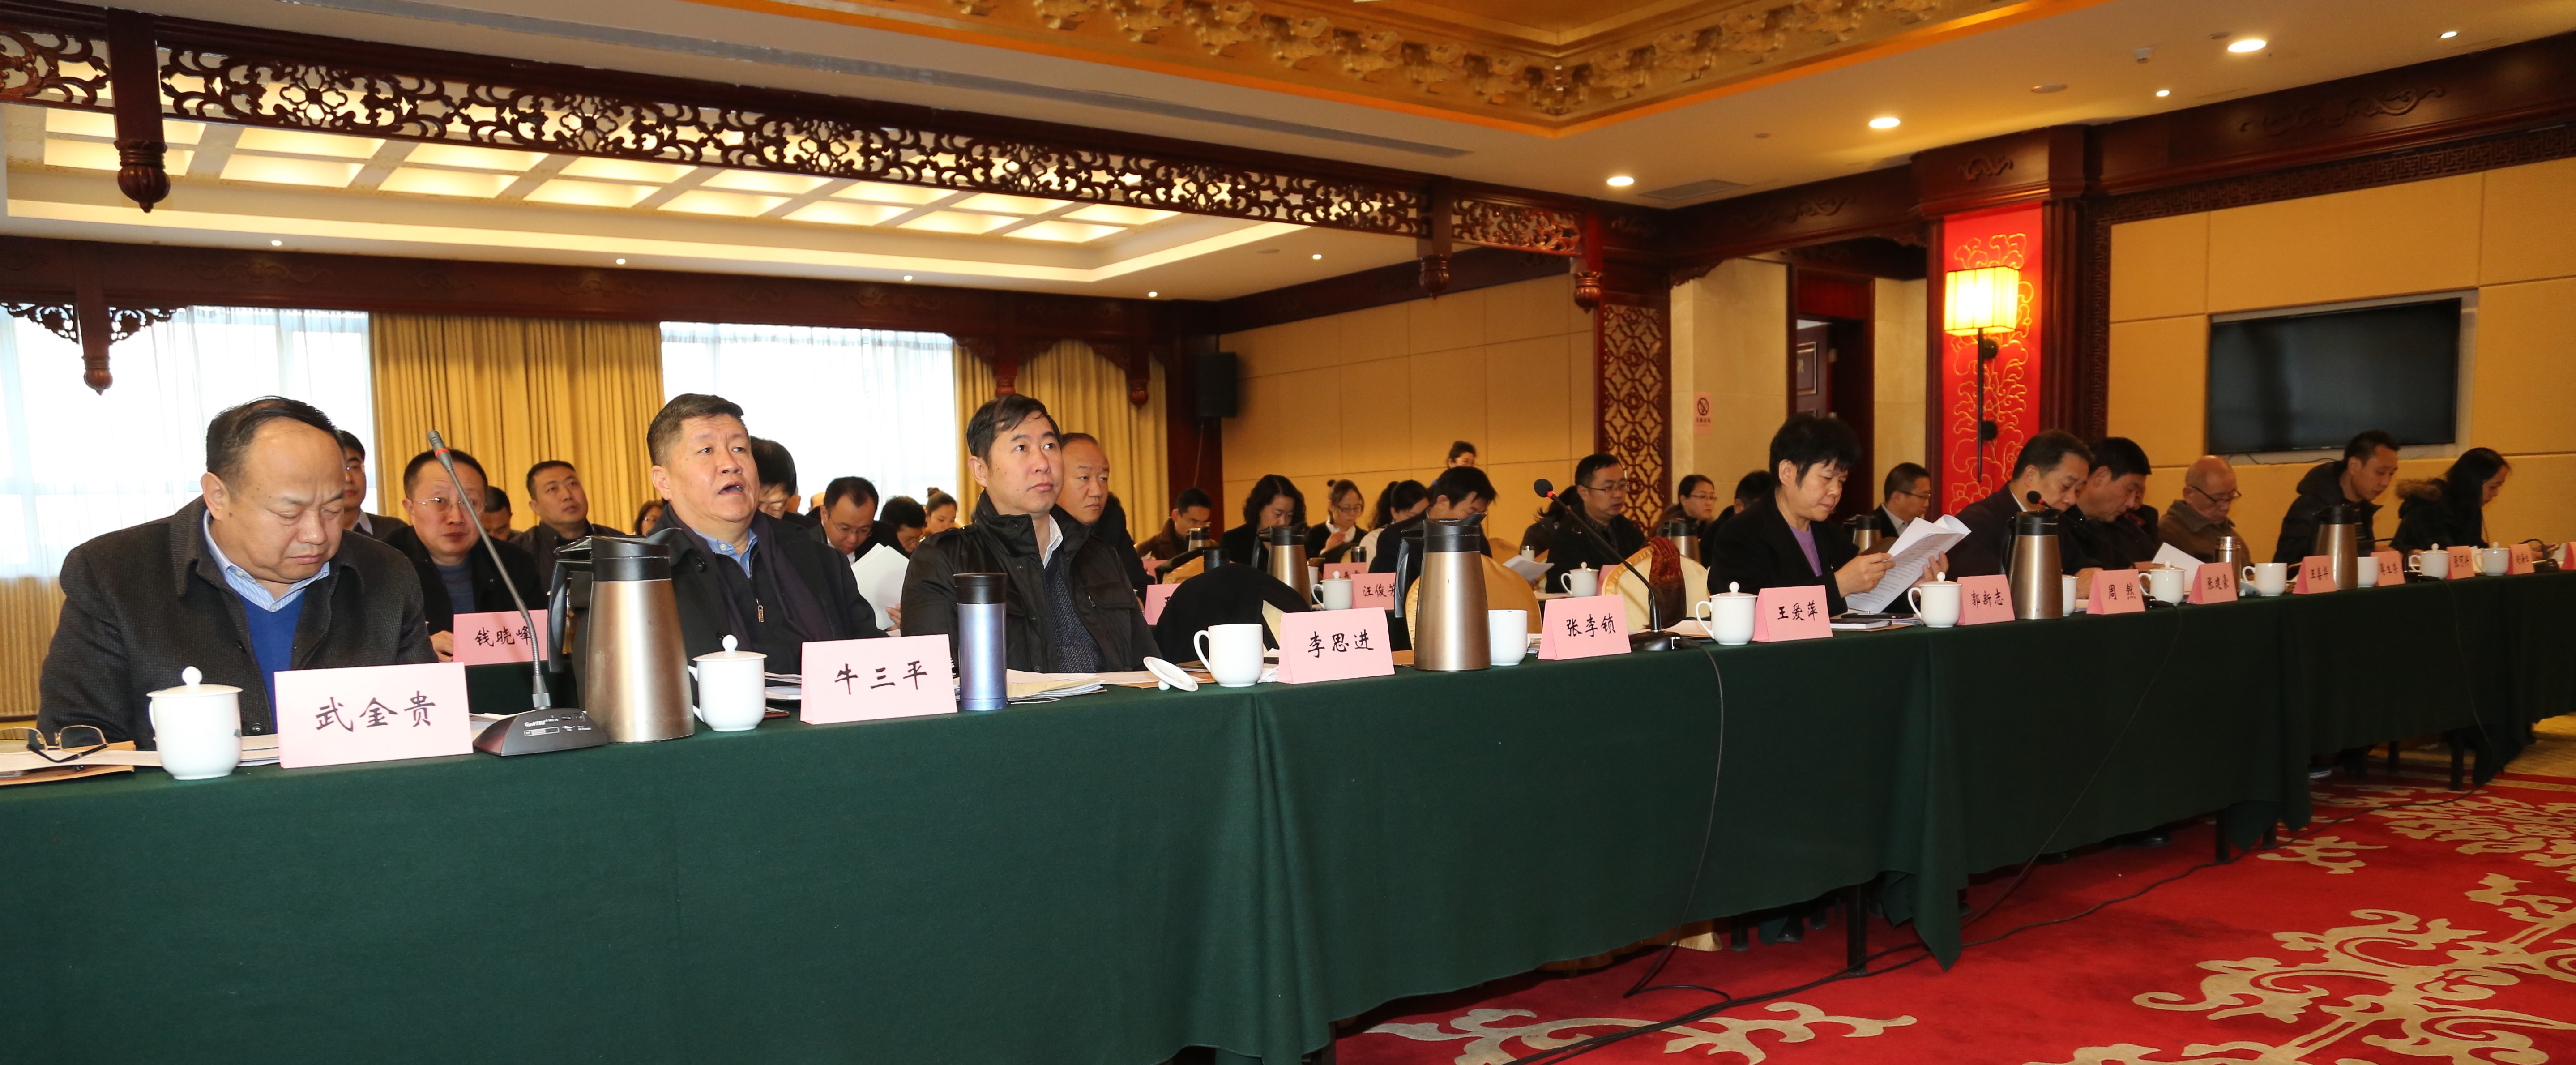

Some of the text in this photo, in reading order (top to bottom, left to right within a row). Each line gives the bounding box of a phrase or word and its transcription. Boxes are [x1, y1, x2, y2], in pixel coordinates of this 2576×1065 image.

[1777, 600, 1818, 621] 王爱萍
[1971, 588, 2004, 609] 郭新志
[475, 626, 531, 647] 钱晓峰
[1566, 613, 1616, 637] 张李锁
[1308, 629, 1375, 658] 李思进
[834, 660, 927, 695] 牛三平
[316, 690, 436, 732] 武金贵
